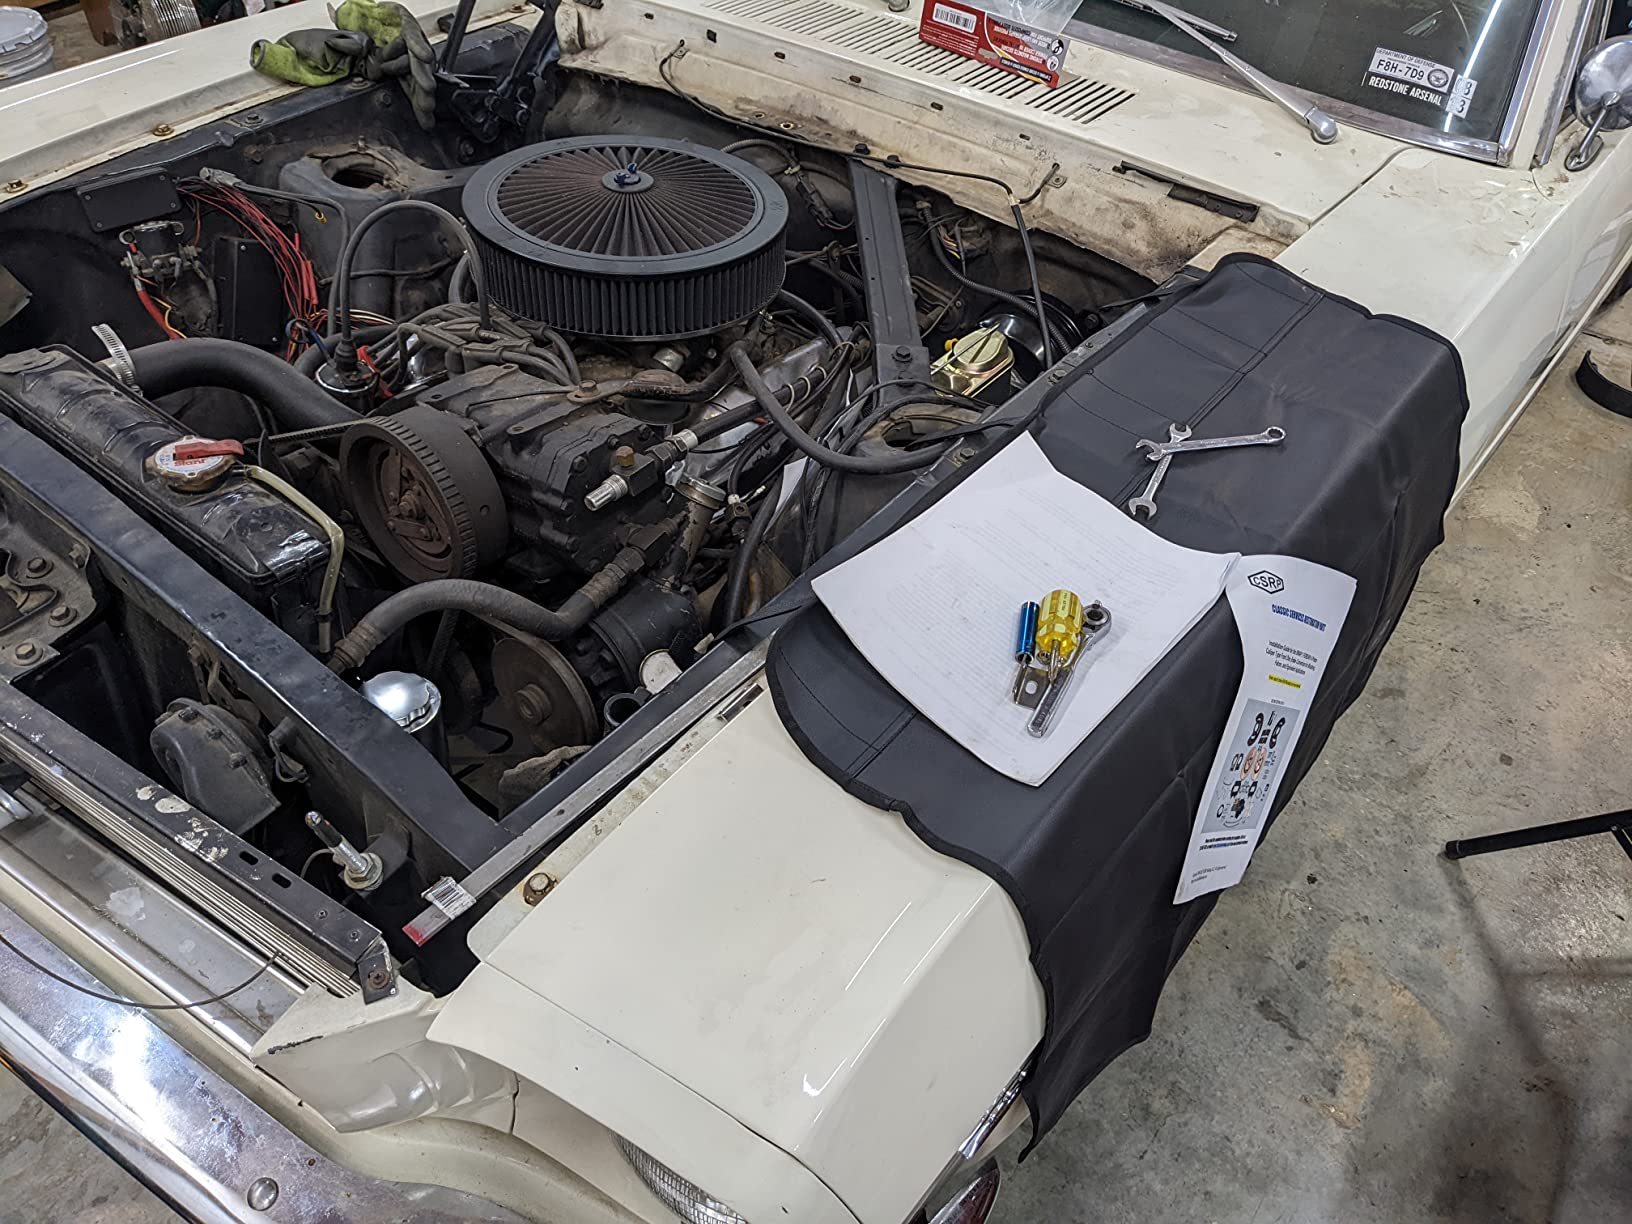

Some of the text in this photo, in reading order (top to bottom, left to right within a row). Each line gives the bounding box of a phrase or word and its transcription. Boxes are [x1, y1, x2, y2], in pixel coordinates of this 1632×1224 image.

[1376, 48, 1407, 60] DEPARTMENT
[1415, 58, 1436, 68] DEFENSE
[1376, 59, 1425, 80] F8H-7D9
[1368, 76, 1442, 106] REDSTONE ARSENAL
[1253, 576, 1281, 589] CSRP
